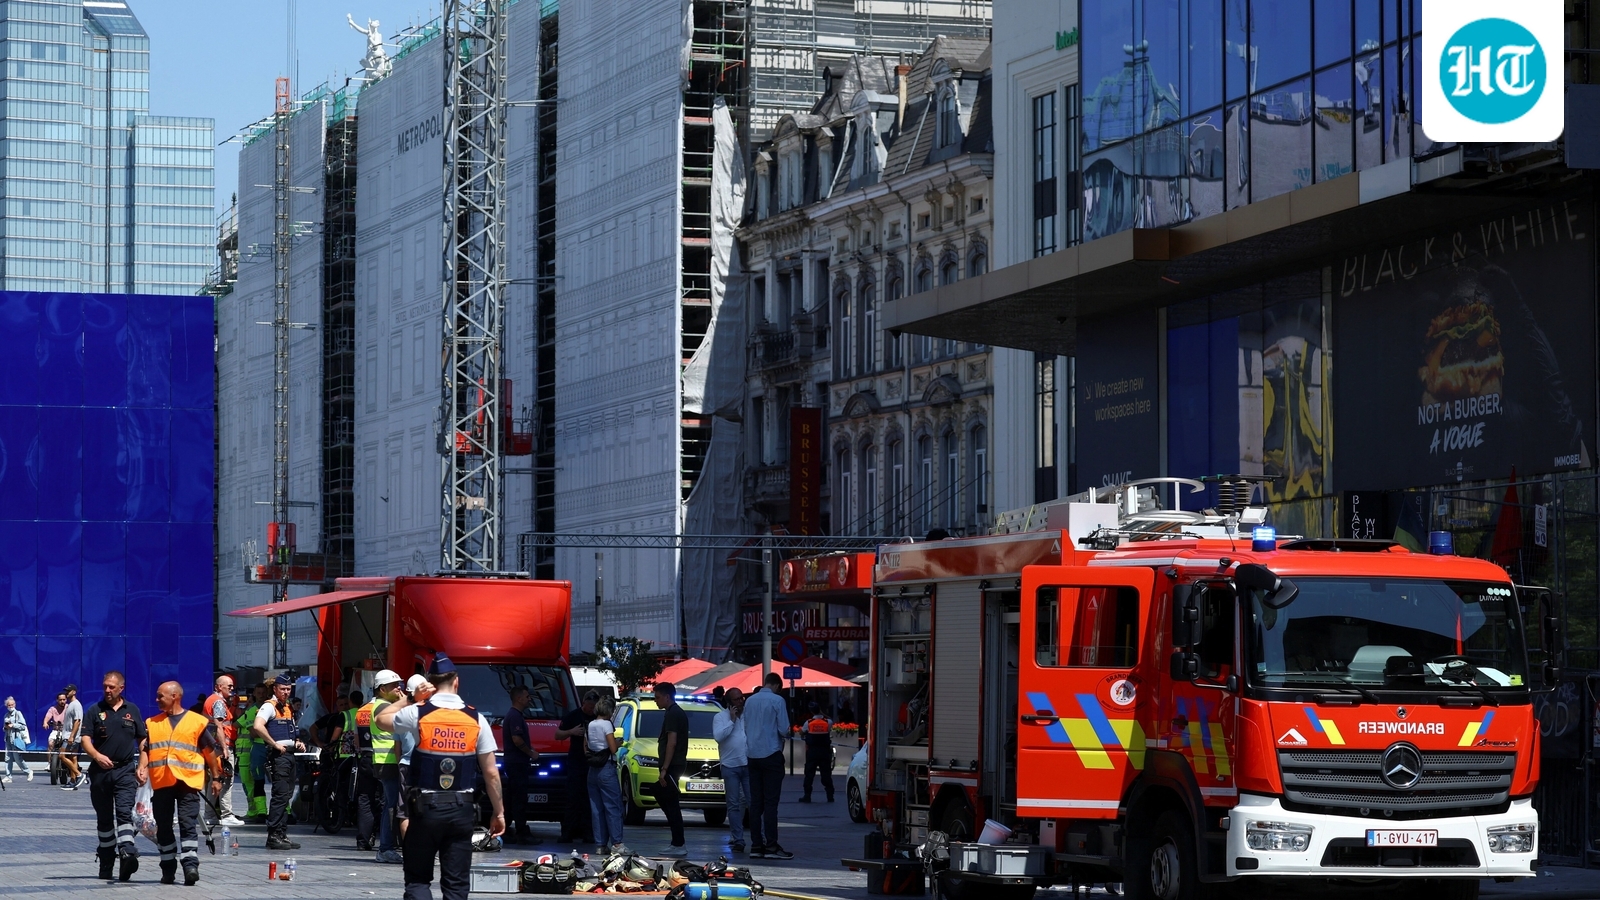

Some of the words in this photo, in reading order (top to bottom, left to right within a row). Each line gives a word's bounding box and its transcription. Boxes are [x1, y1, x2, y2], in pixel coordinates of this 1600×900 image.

[398, 112, 443, 156] METROPOL
[1094, 382, 1106, 398] We
[1107, 380, 1128, 396] create
[1129, 378, 1144, 391] new
[1095, 402, 1134, 422] workspaces
[1135, 398, 1151, 414] here
[1418, 403, 1440, 426] NOT
[1444, 401, 1452, 421] A
[1454, 393, 1503, 420] BURGER,
[1430, 428, 1440, 455] A
[1444, 422, 1486, 452] VOGUE
[1554, 454, 1581, 467] IMMOBEL
[801, 423, 810, 536] BRUSSELS
[1352, 494, 1360, 540] BLACK
[431, 738, 466, 750] Politie
[434, 728, 466, 738] Police
[1376, 832, 1436, 844] 1-GYU-417
